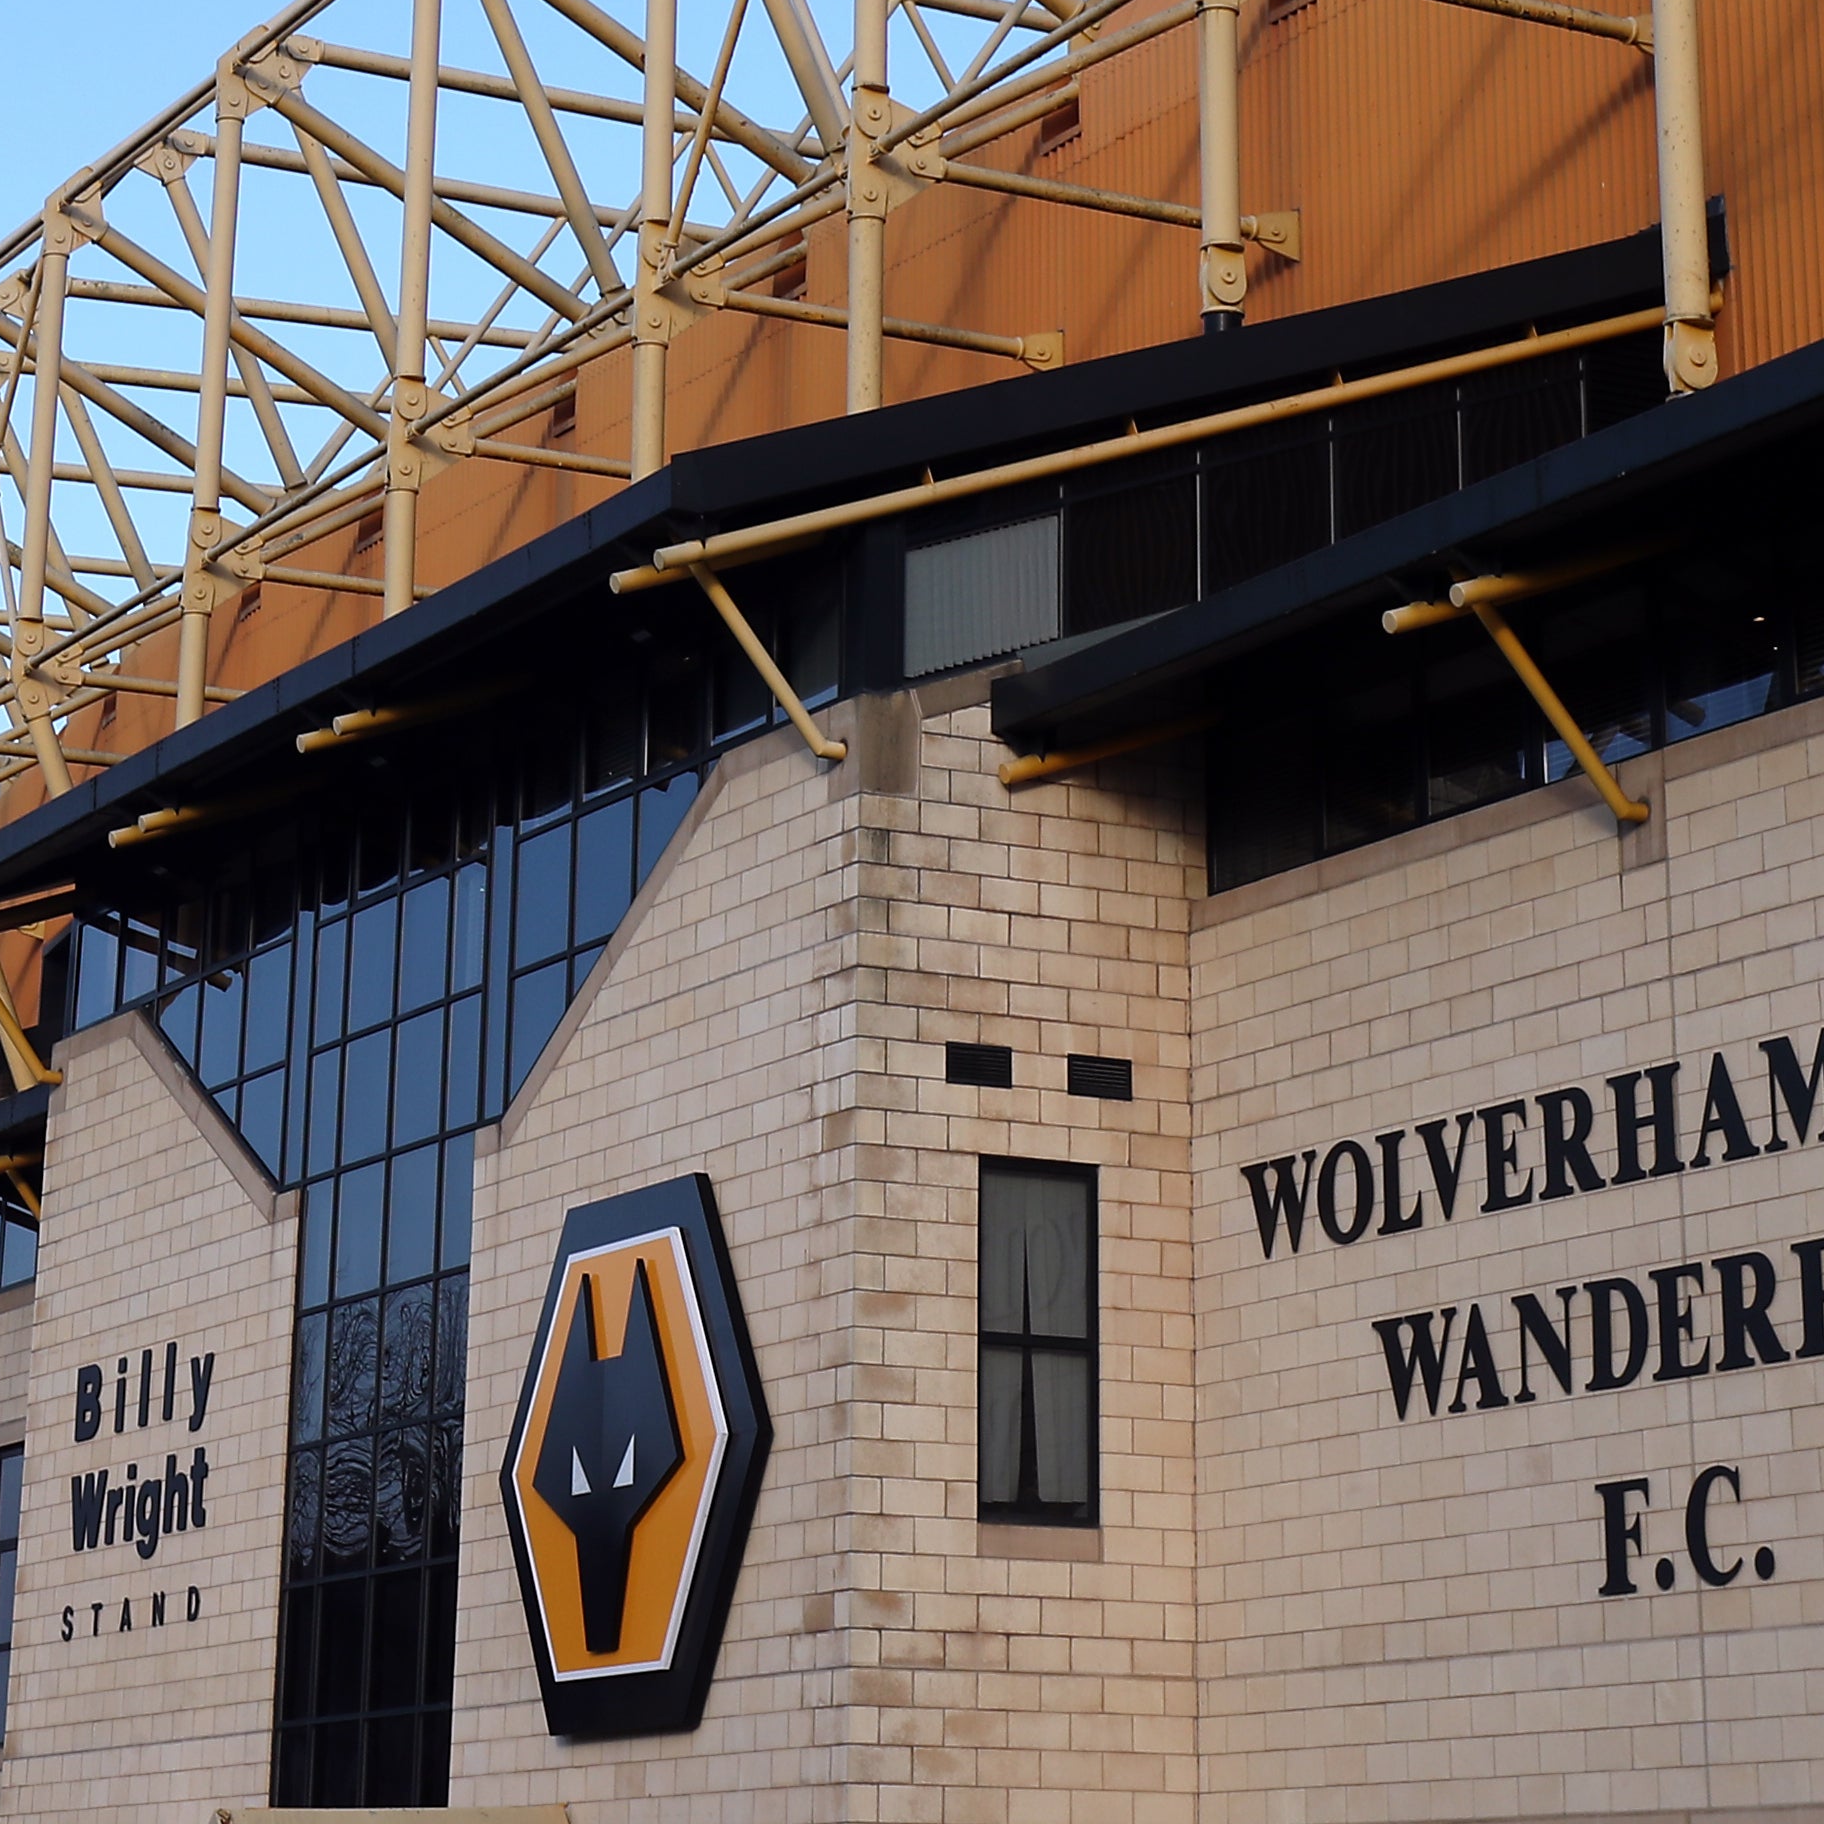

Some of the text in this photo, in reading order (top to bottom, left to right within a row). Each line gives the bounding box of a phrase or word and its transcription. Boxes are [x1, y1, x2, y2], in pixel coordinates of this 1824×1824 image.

[74, 1341, 215, 1443] Billy
[71, 1447, 208, 1560] Wright
[1595, 1464, 1775, 1596] F.C.
[61, 1586, 201, 1642] STAND
